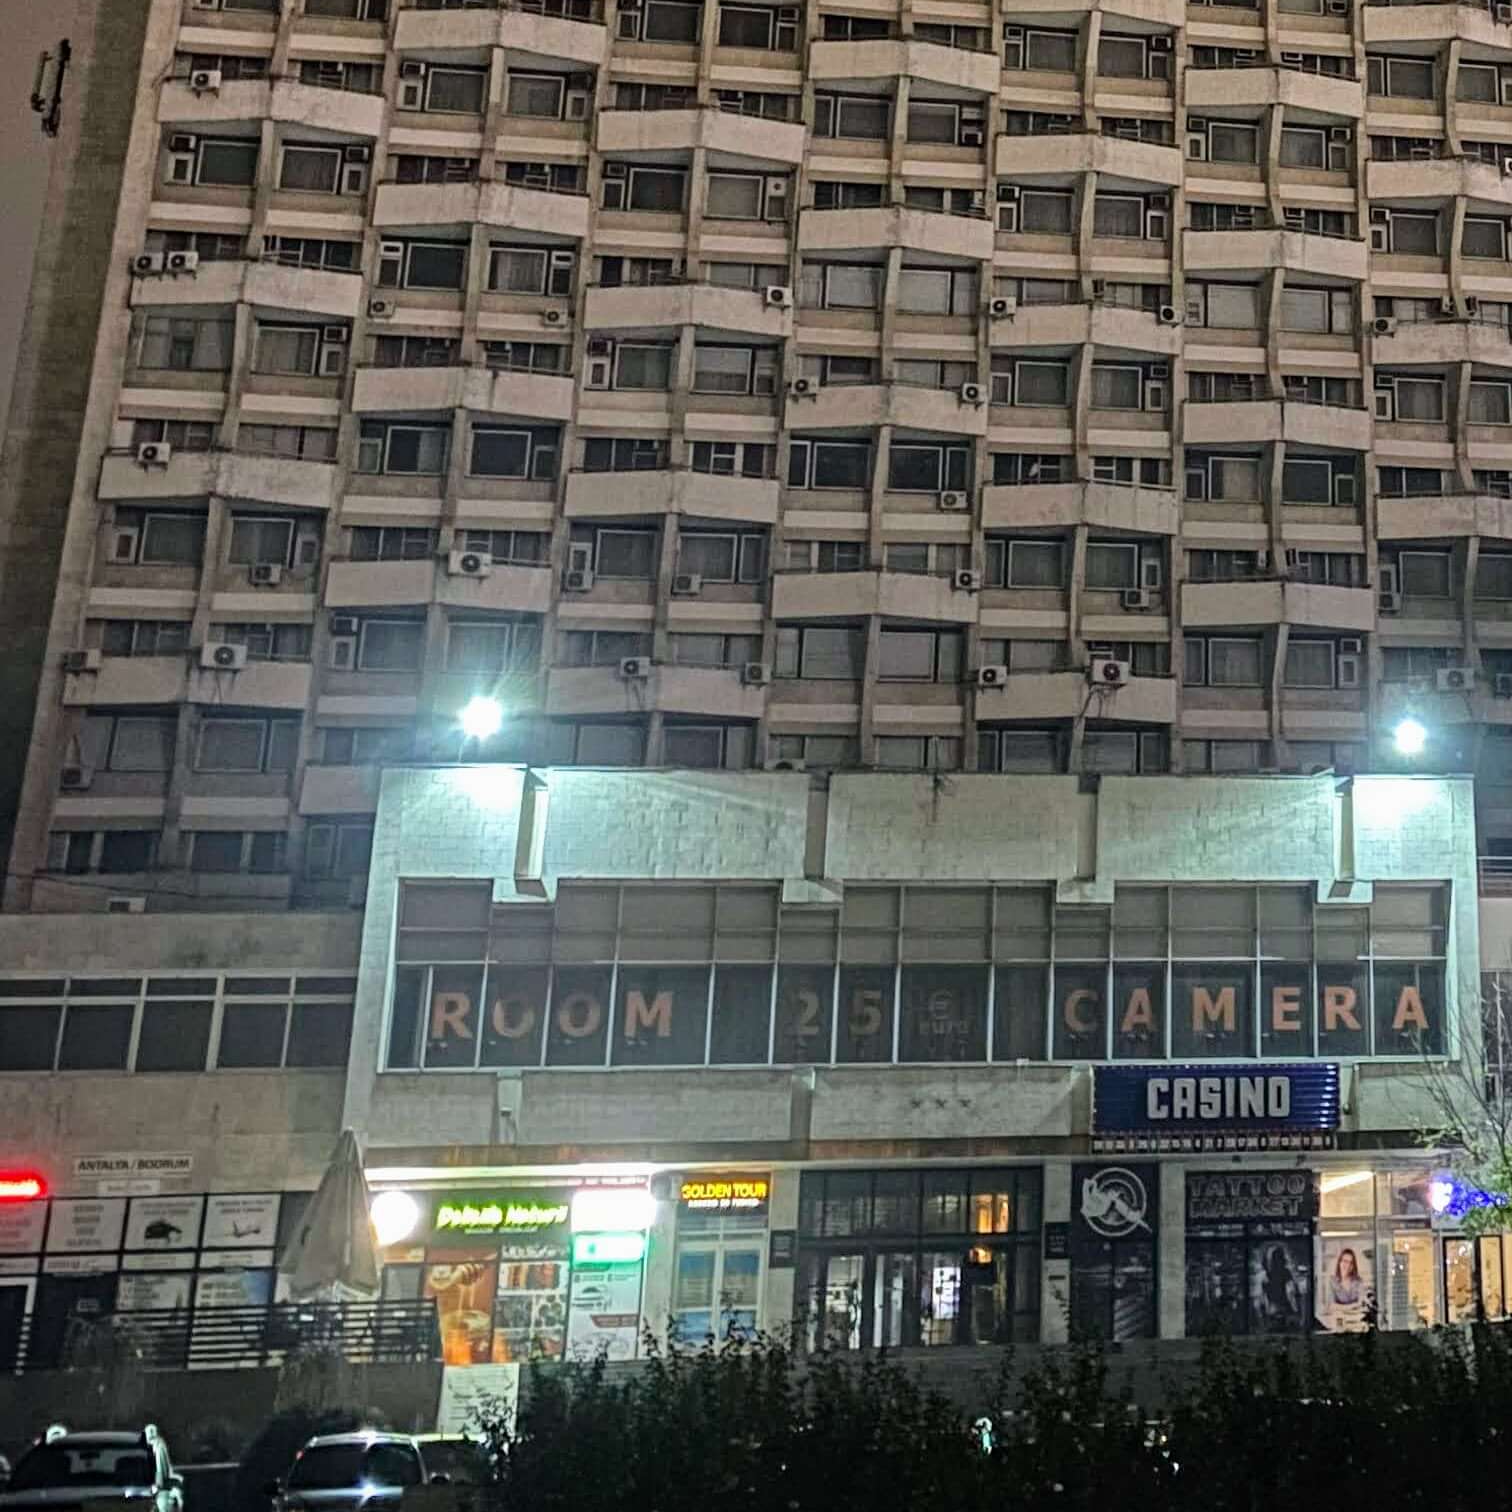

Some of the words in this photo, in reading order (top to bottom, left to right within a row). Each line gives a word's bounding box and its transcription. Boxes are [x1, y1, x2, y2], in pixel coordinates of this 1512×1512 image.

[431, 990, 675, 1040] ROOM
[1064, 985, 1429, 1033] CAMERA
[1146, 1076, 1291, 1119] CASINO
[78, 1158, 129, 1171] ANTALYA
[681, 1183, 731, 1199] GOLDEN
[732, 1181, 767, 1198] TOUR
[1190, 1174, 1306, 1196] TATTOO
[1190, 1197, 1304, 1218] MARKET
